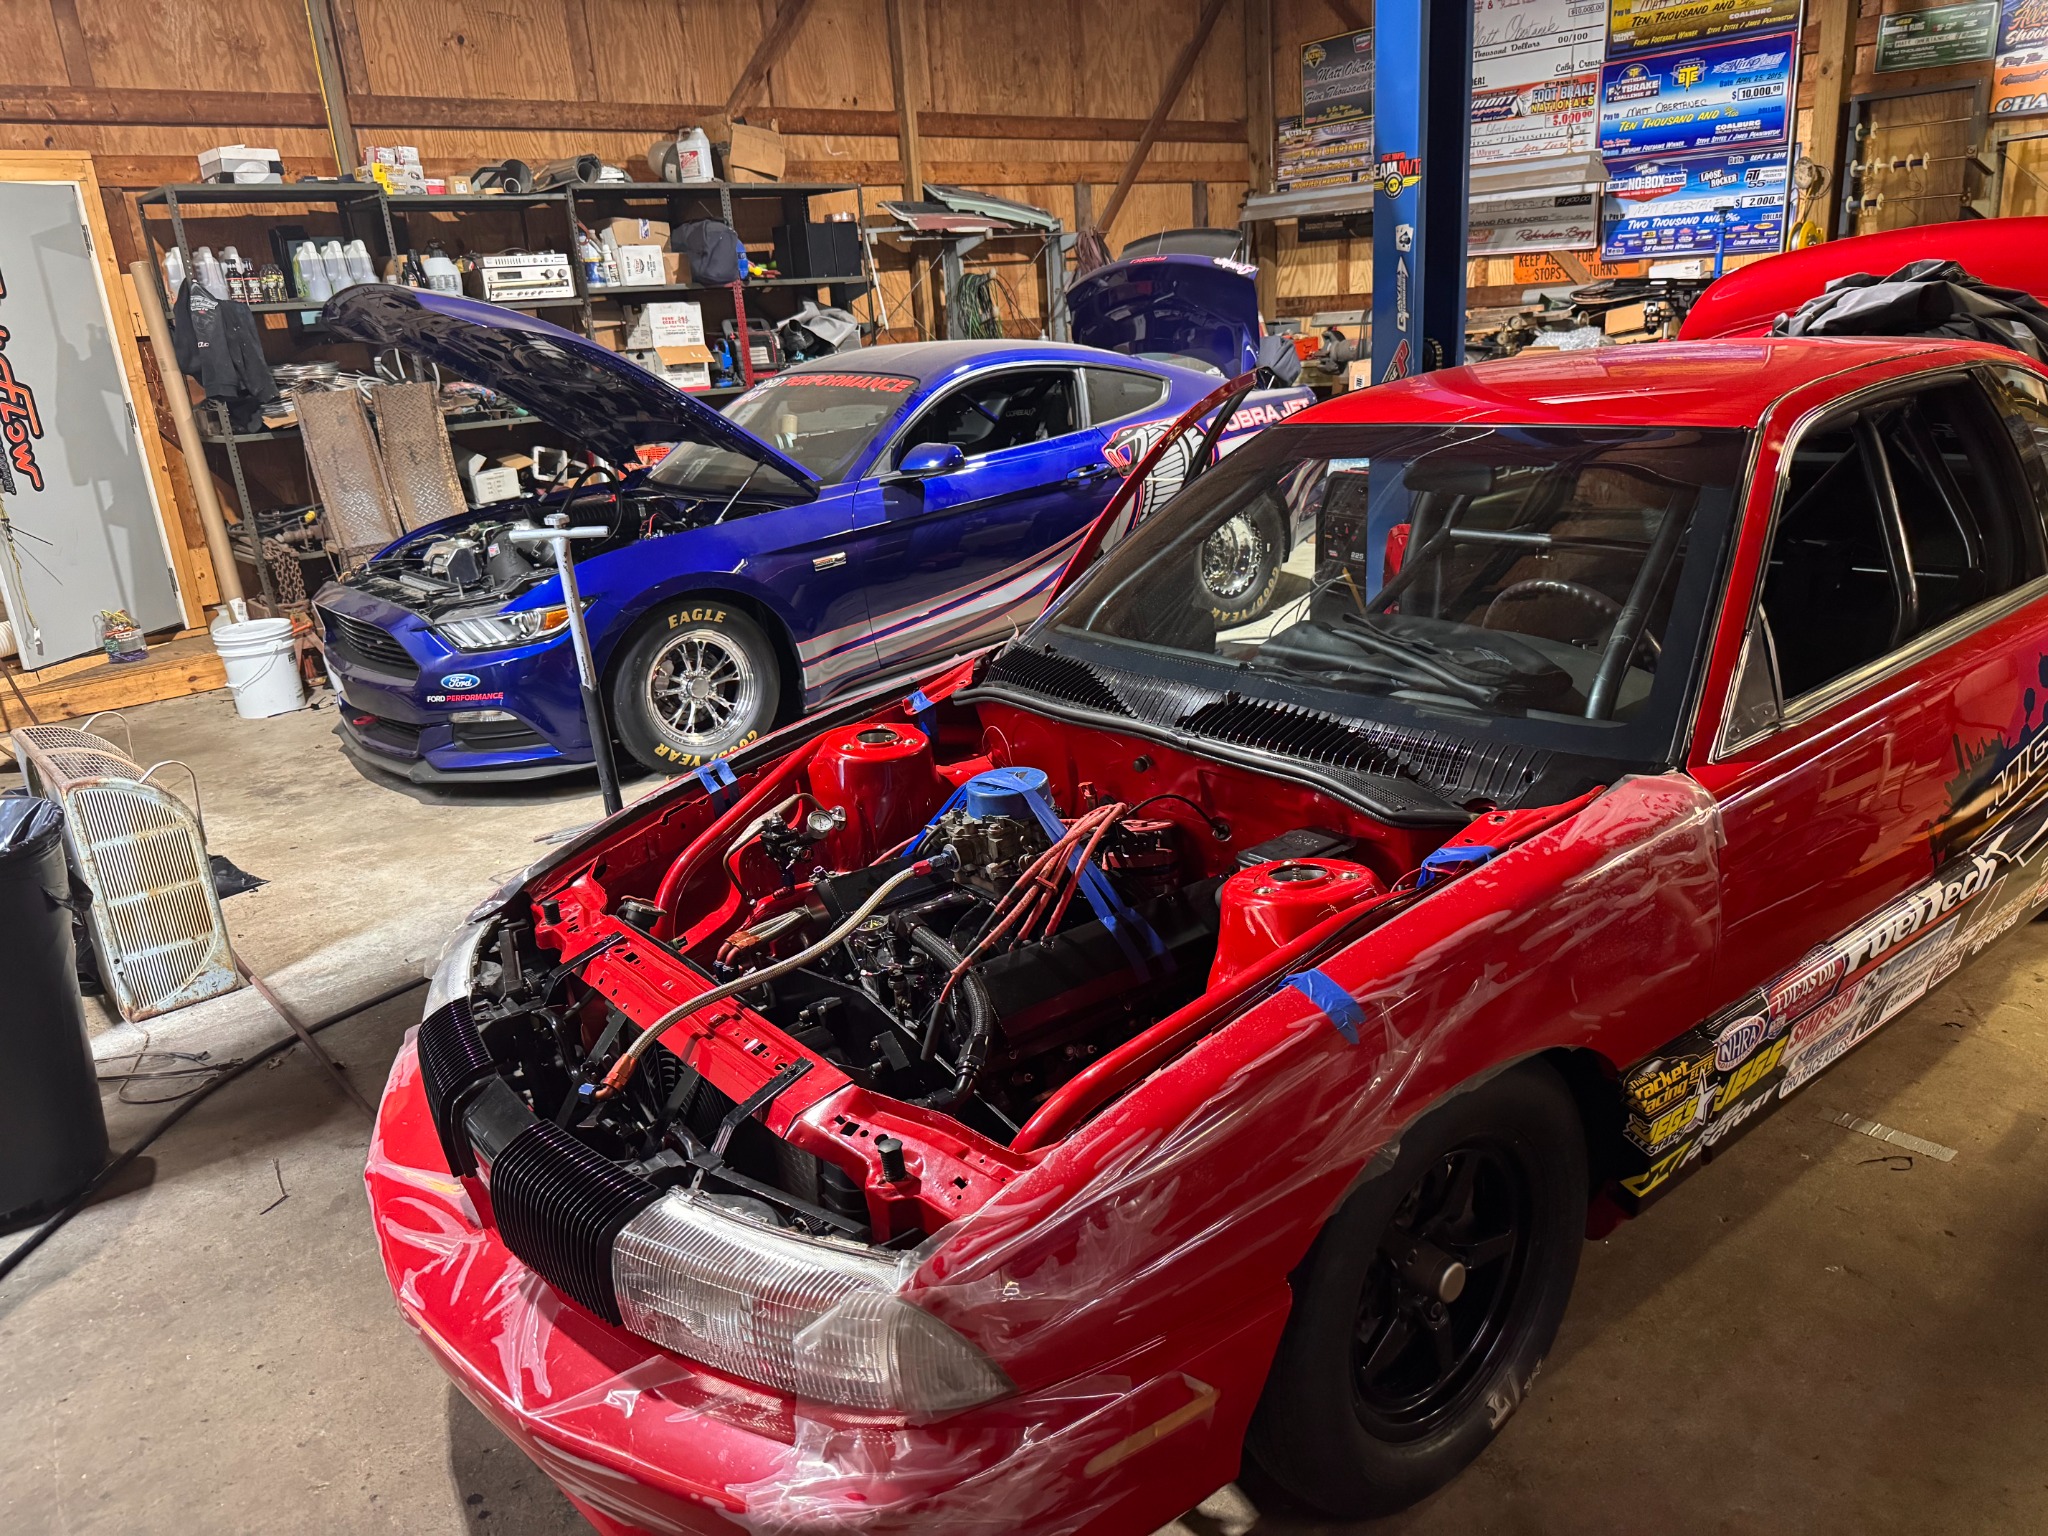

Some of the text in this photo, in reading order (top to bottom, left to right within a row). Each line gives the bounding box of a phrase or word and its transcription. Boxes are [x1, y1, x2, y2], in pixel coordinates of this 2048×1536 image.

[1632, 1, 1734, 27] TEN THOUSAND AND
[1532, 82, 1595, 103] FOOT BRAKE
[1531, 96, 1594, 114] NATIONALS
[1619, 121, 1636, 132] TEN
[1641, 113, 1694, 130] THOUSAND
[1697, 110, 1720, 122] AND
[1715, 119, 1761, 131] COALBURG
[1374, 158, 1421, 179] EAM M/T
[1701, 170, 1722, 182] LOOSE
[1711, 174, 1737, 187] ROCKER
[1628, 219, 1649, 230] TWO
[1652, 215, 1700, 228] THOUSAND
[1518, 250, 1595, 268] KEEP FOR
[1534, 263, 1618, 281] STOPS TURNS
[779, 375, 915, 393] PERFORMANCE
[1206, 407, 1275, 434] COBRA
[668, 608, 727, 630] EAGLE
[427, 692, 504, 703] FORD PERFORMANCE
[1775, 961, 1837, 1014] LUCAS OIL
[1788, 985, 1859, 1050] SIMPSON
[1722, 1026, 1757, 1062] NHRA
[1629, 1074, 1646, 1089] This
[1634, 1060, 1690, 1100] racket
[1713, 1035, 1790, 1112] JEGS
[1781, 1074, 1800, 1096] PRO
[1801, 1057, 1823, 1082] RACE
